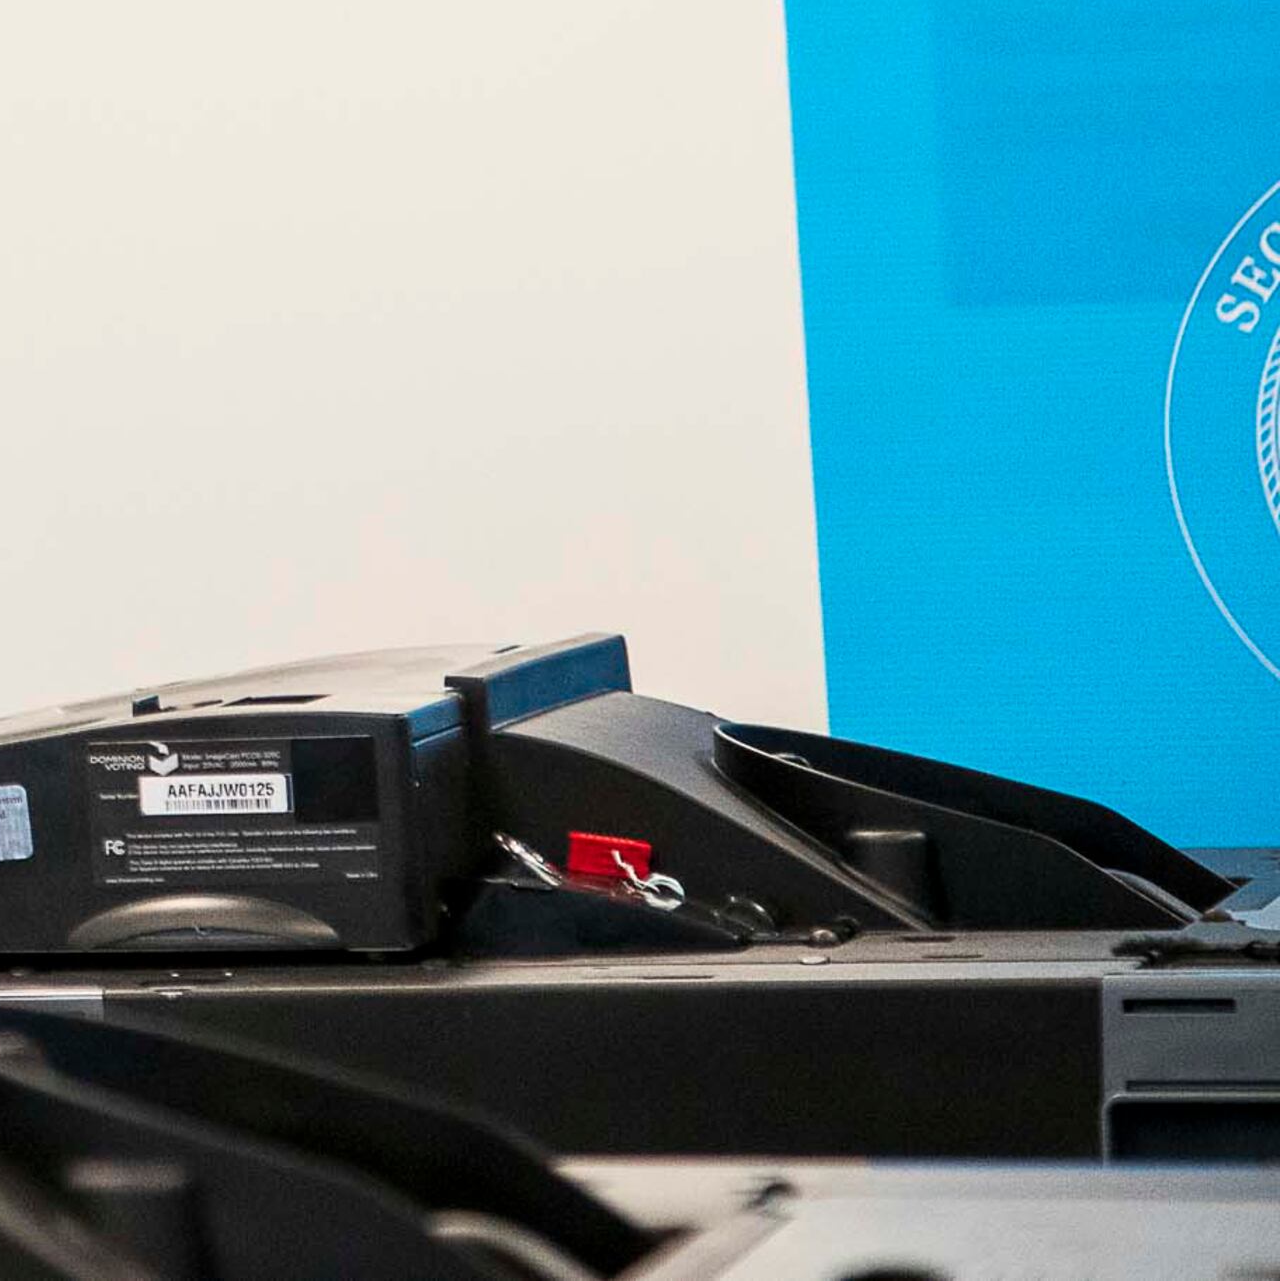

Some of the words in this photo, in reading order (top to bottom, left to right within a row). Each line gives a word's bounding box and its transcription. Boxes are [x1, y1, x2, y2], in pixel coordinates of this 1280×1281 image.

[90, 755, 145, 764] DOMINION
[105, 762, 145, 771] VOTING
[167, 782, 275, 798] AAFAJJW0125
